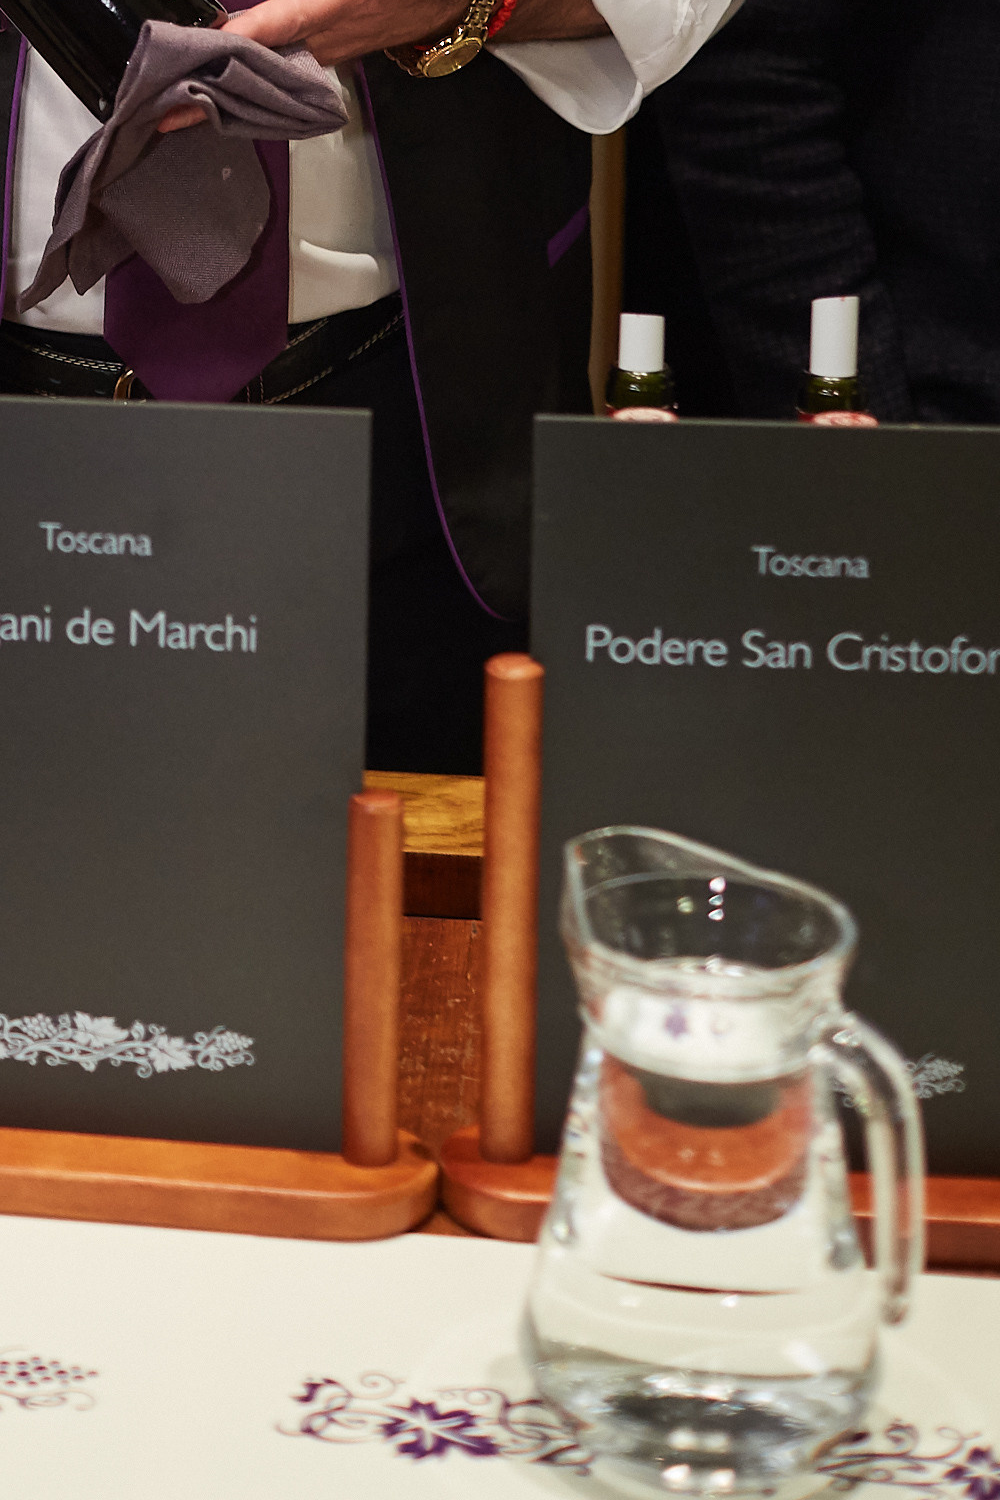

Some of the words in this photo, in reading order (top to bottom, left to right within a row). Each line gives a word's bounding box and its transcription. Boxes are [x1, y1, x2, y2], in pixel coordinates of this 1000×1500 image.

[38, 520, 153, 557] Toscana
[749, 545, 871, 579] Toscana
[65, 606, 116, 646] de
[128, 608, 258, 653] Marchi
[584, 623, 729, 668] Podere
[740, 628, 813, 670] San
